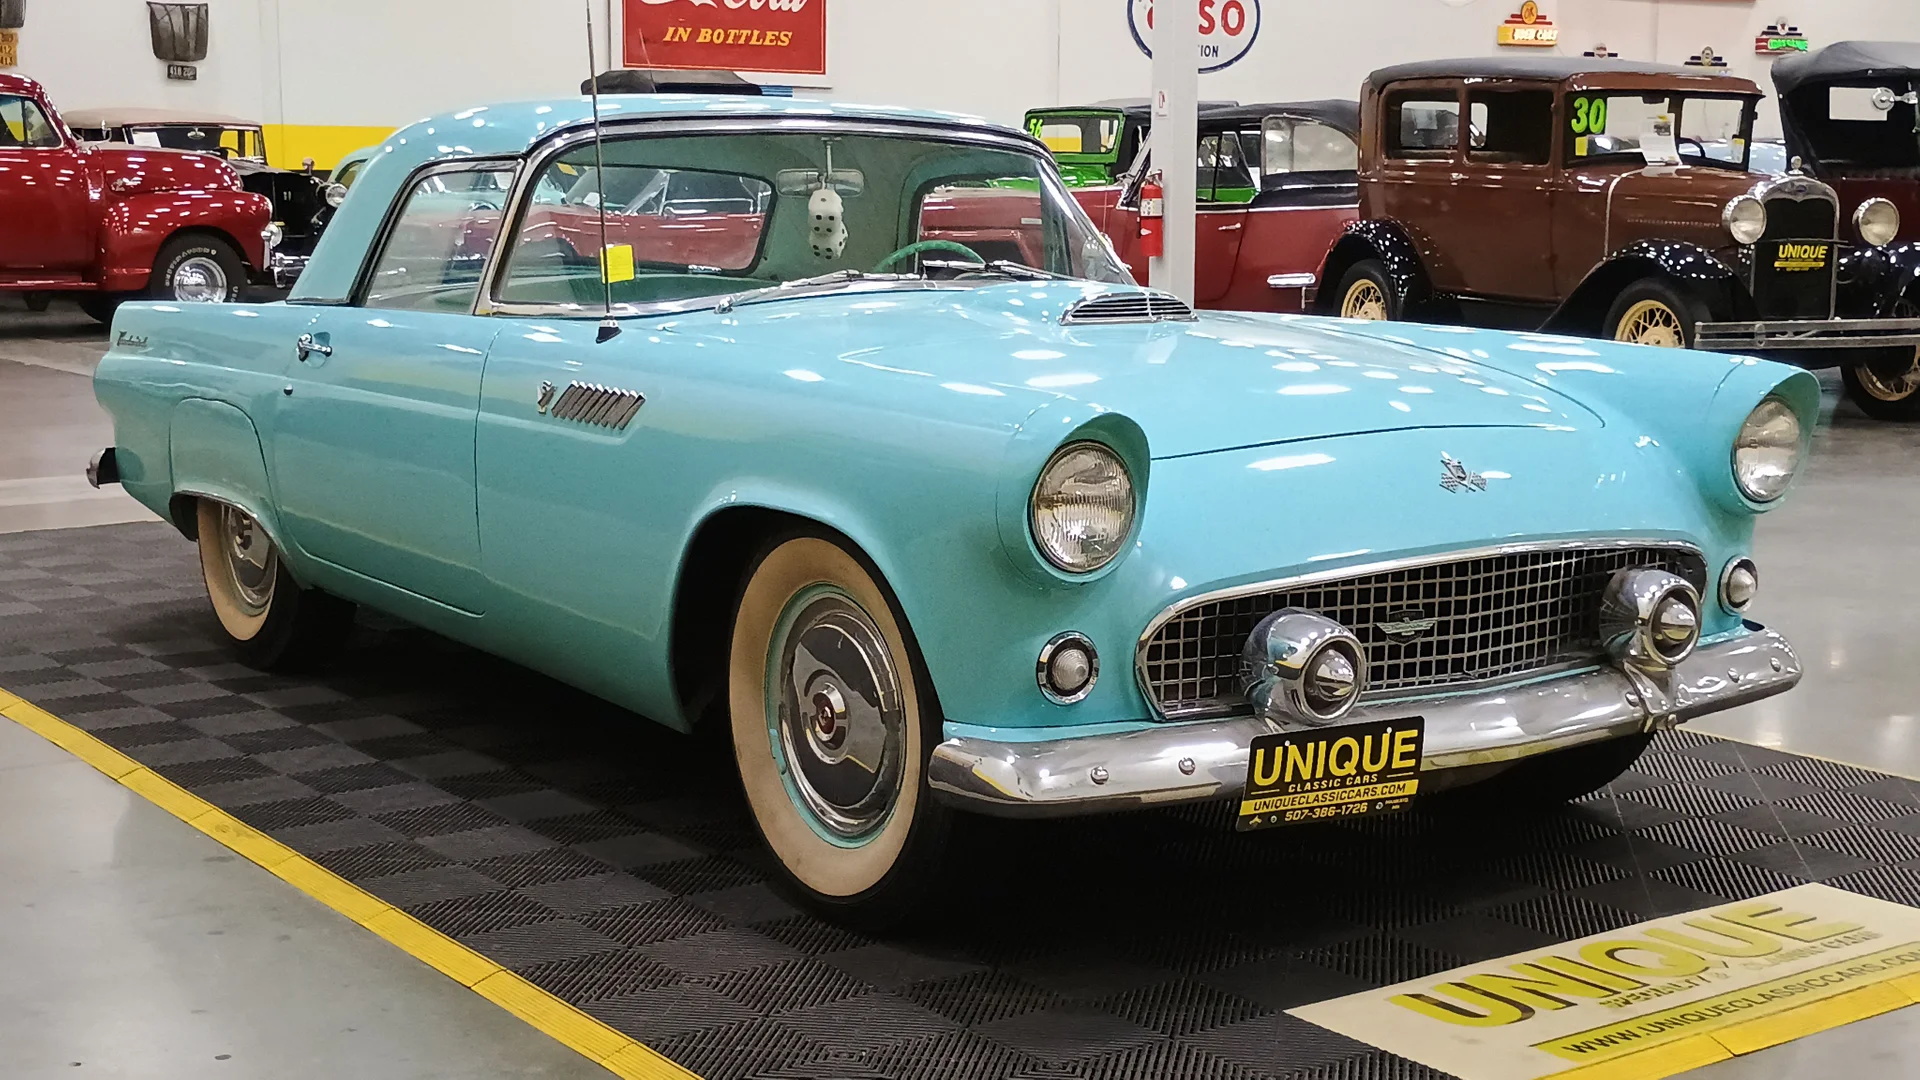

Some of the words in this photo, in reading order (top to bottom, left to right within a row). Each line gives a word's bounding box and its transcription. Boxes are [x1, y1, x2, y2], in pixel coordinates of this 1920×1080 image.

[663, 26, 692, 42] IN
[696, 28, 793, 46] BOTTLES
[1571, 97, 1606, 134] 30
[1028, 118, 1043, 140] 56
[1778, 243, 1829, 259] UNIQUE
[1253, 729, 1419, 786] UNIQUE
[1288, 779, 1341, 793] CLASSIC
[1346, 774, 1378, 786] CARS
[1253, 783, 1407, 811] UNIQUECLASSICCARS.COM
[1284, 802, 1368, 822] 507-386-1726
[1389, 903, 1865, 1028] UNIQUE
